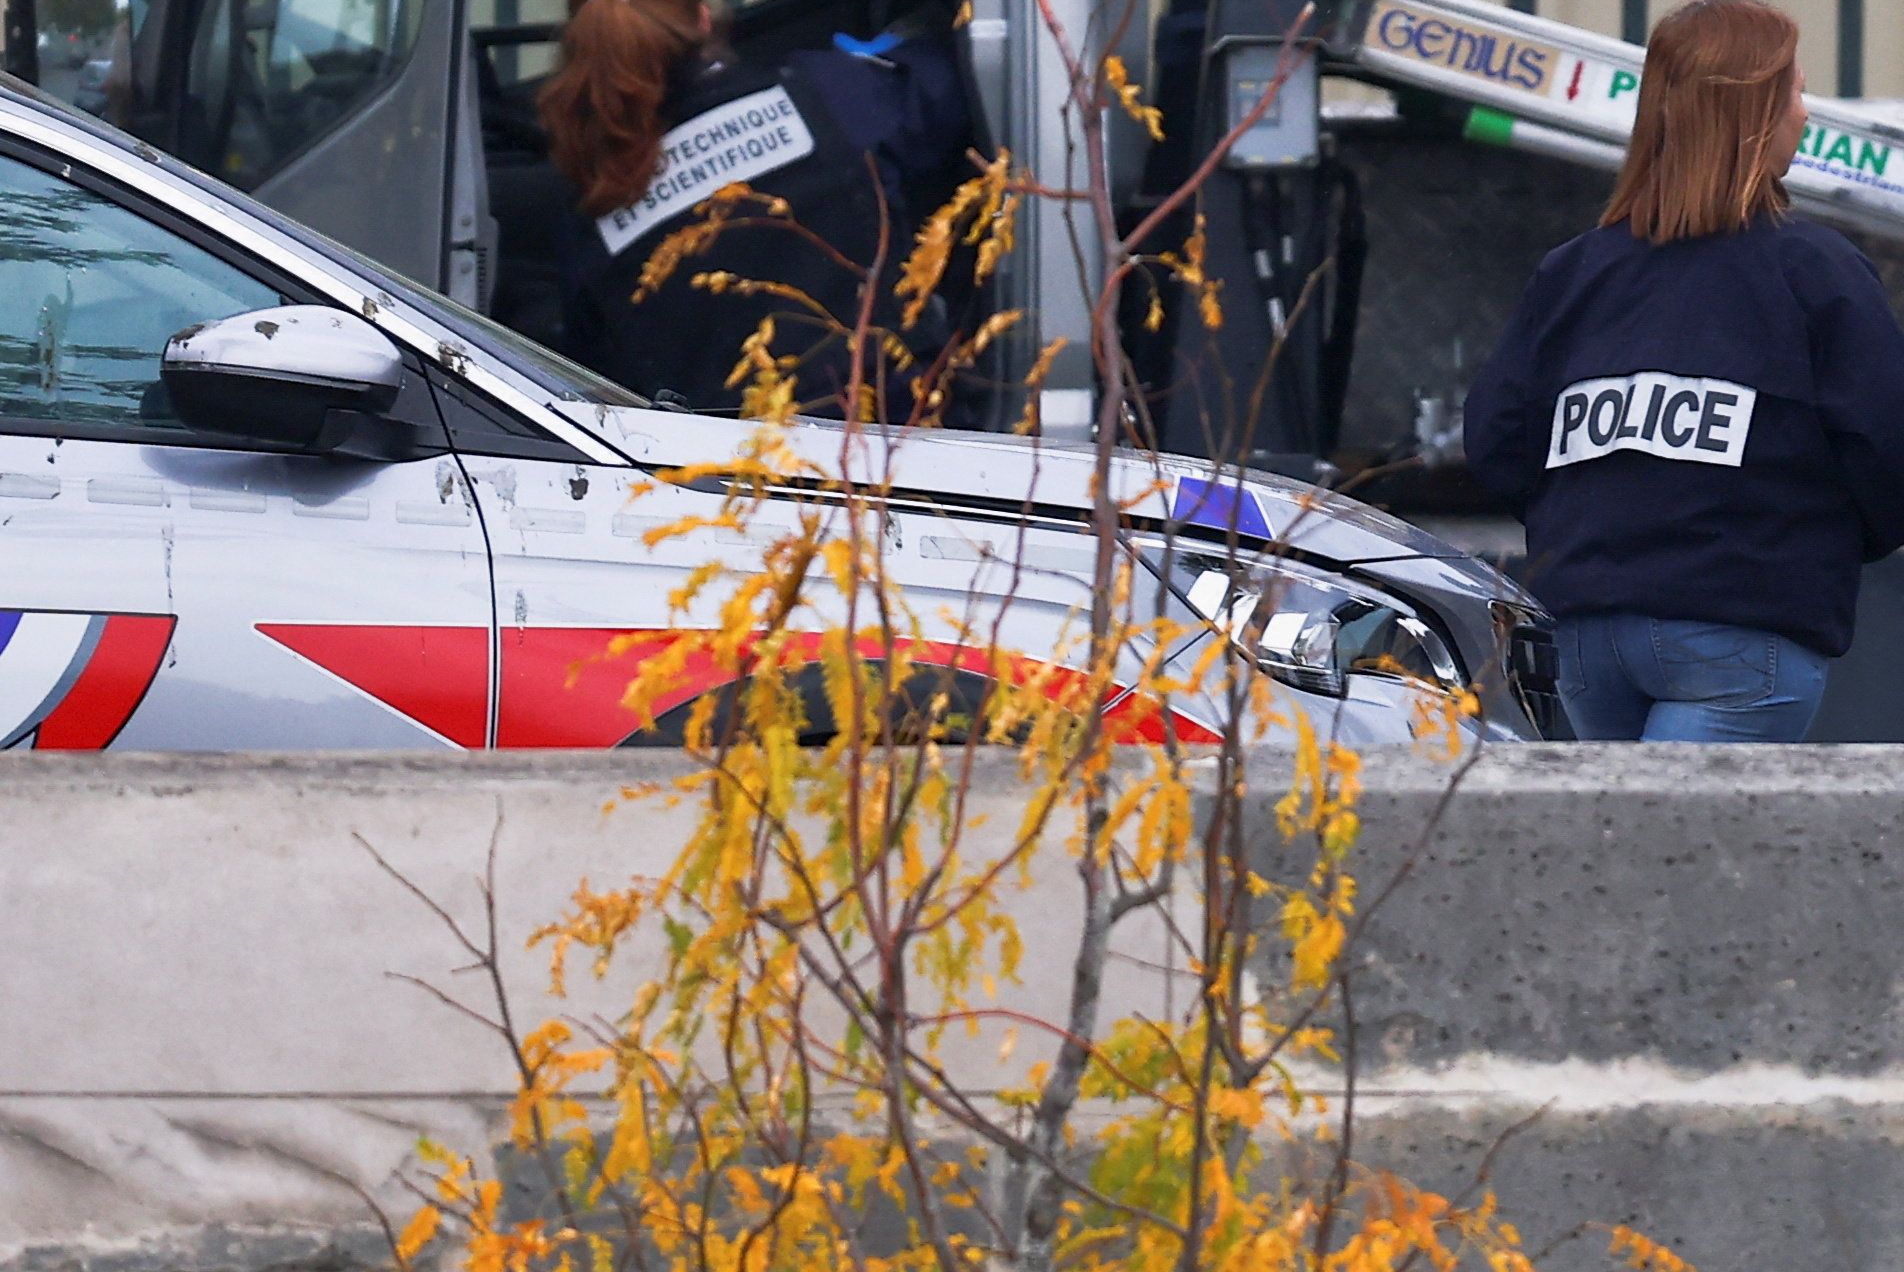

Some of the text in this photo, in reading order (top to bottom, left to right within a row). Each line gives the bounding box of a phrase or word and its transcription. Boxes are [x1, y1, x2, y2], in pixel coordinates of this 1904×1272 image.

[643, 126, 793, 209] SCIENTIFIQUE
[666, 99, 793, 165] TECHNIQUE
[1559, 384, 1738, 455] POLICE
